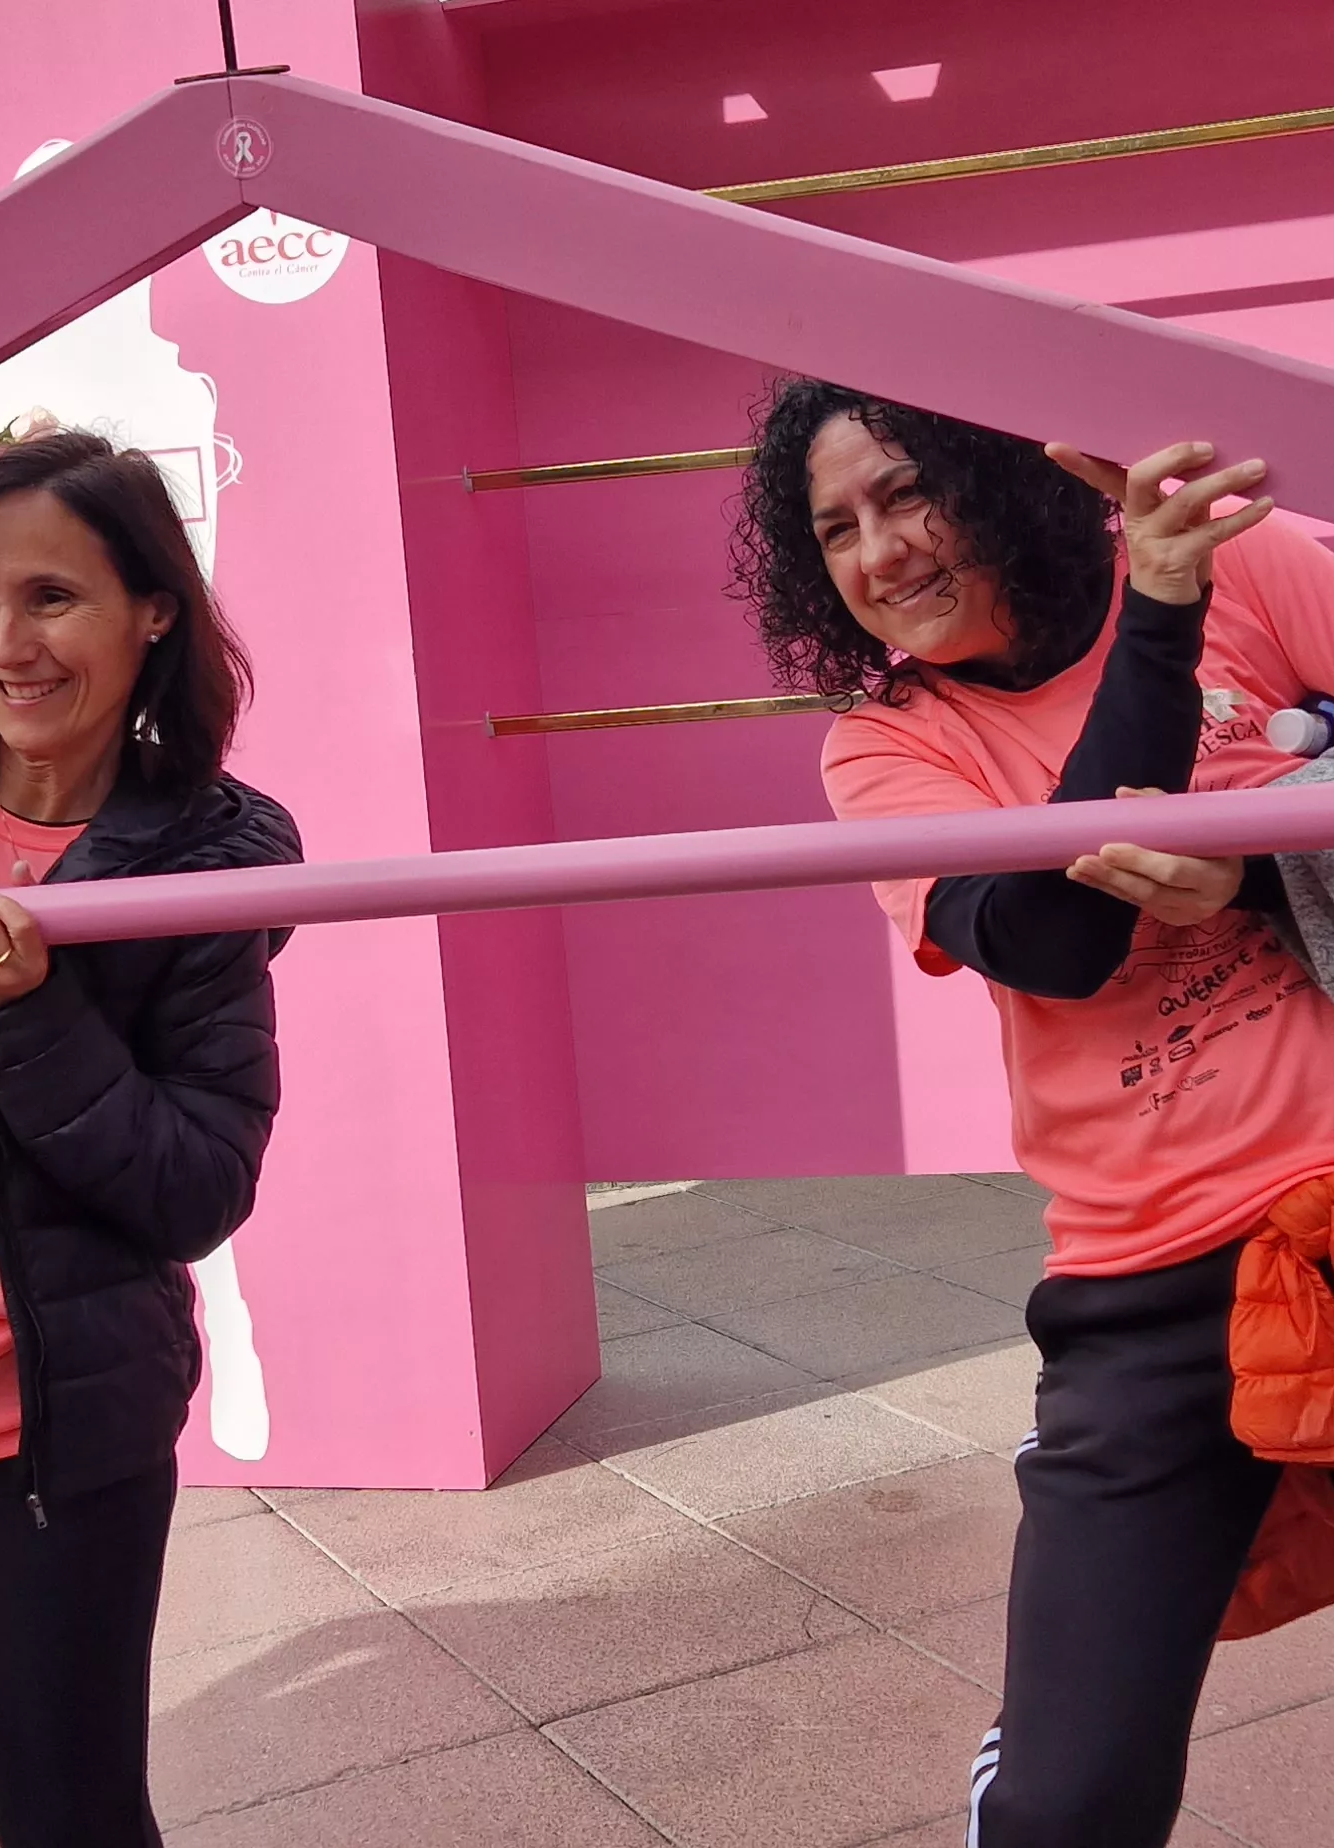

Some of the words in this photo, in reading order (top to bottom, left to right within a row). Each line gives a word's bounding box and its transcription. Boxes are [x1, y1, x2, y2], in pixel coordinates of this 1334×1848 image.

[220, 229, 333, 267] aecc
[274, 265, 283, 275] el
[1158, 949, 1254, 1017] QUIÉRETE
